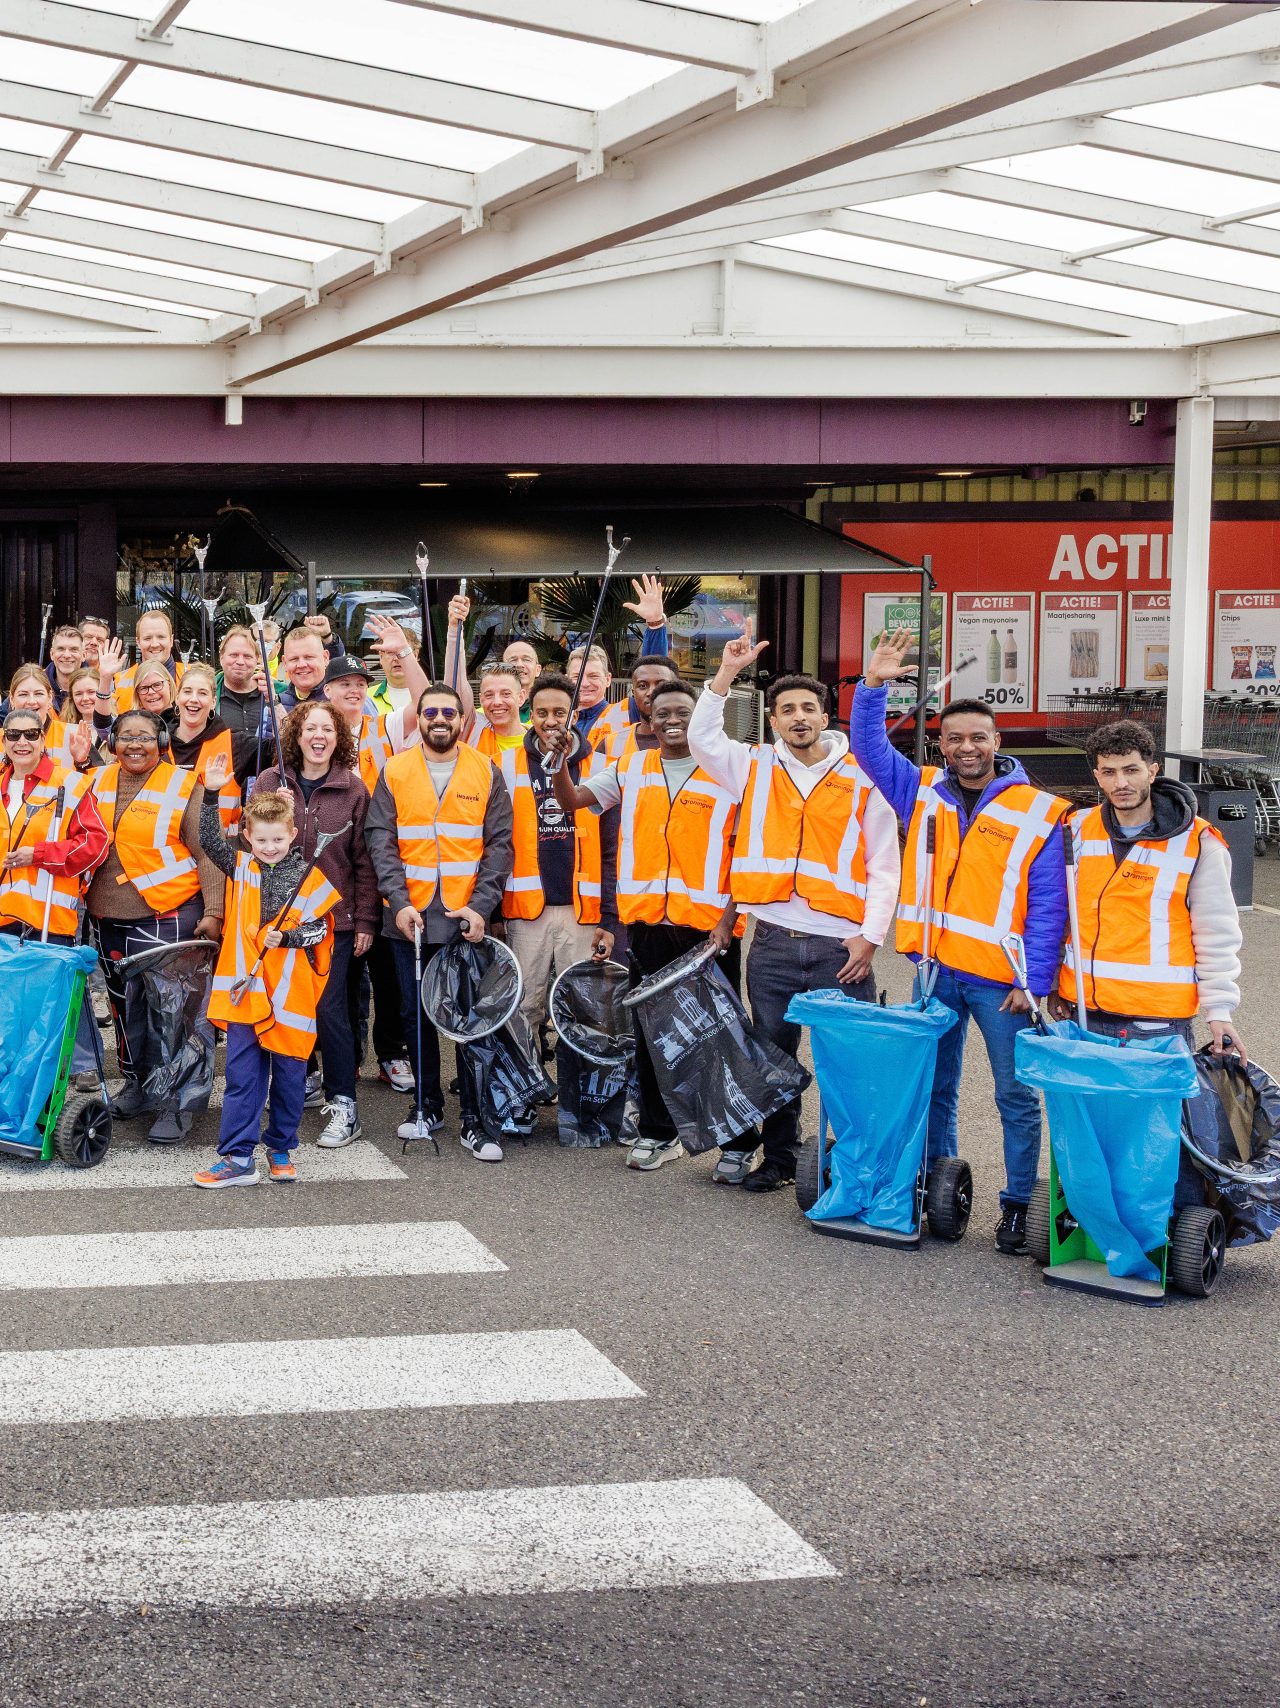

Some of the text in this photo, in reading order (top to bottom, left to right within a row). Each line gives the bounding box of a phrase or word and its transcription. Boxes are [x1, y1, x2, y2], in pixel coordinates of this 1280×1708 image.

[972, 597, 1014, 608] ACTIE!
[1059, 596, 1101, 608] ACTIE!
[1147, 596, 1171, 607] ACT
[1234, 595, 1275, 606] ACTIE!
[978, 688, 1024, 704] -50%
